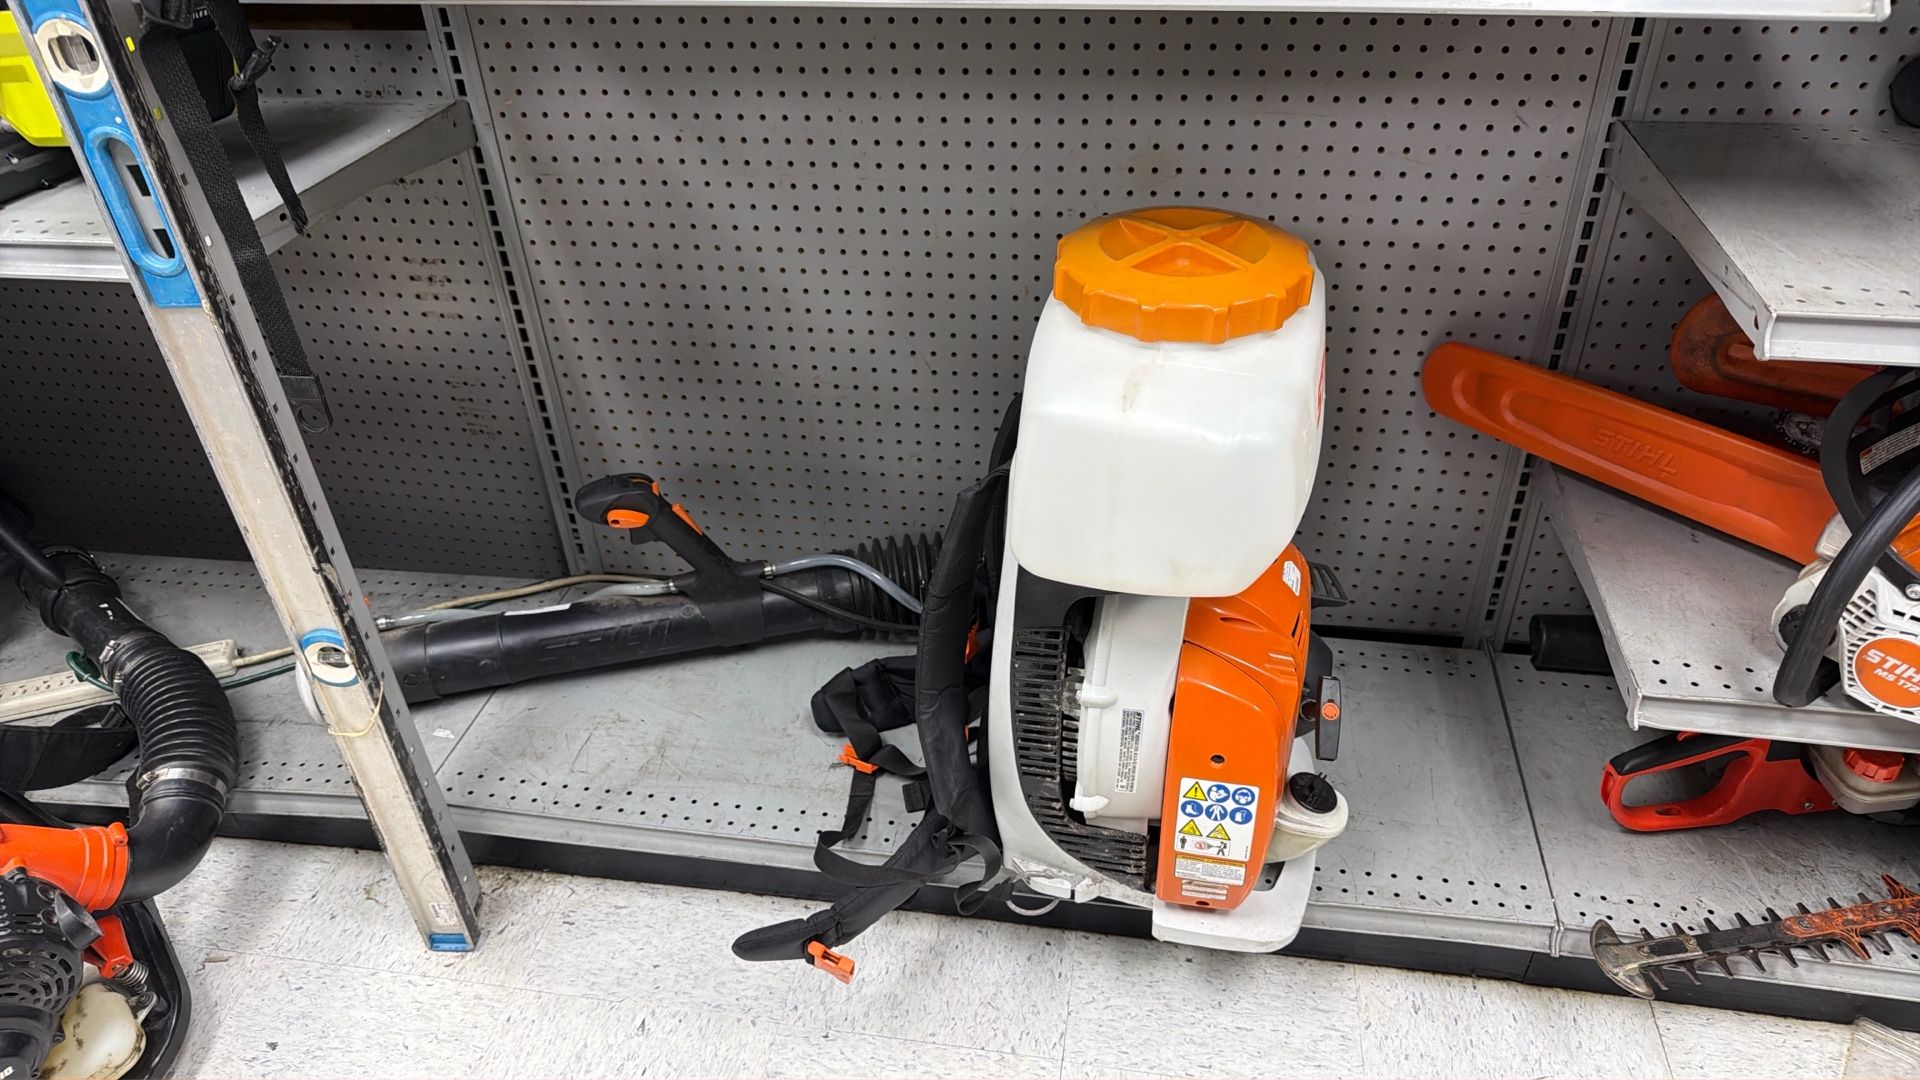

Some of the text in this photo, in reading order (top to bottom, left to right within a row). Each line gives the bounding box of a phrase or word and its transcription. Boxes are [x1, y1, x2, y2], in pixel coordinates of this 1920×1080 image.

[1591, 427, 1679, 476] STIHL
[1862, 648, 1920, 684] STIH
[1873, 668, 1898, 682] MS
